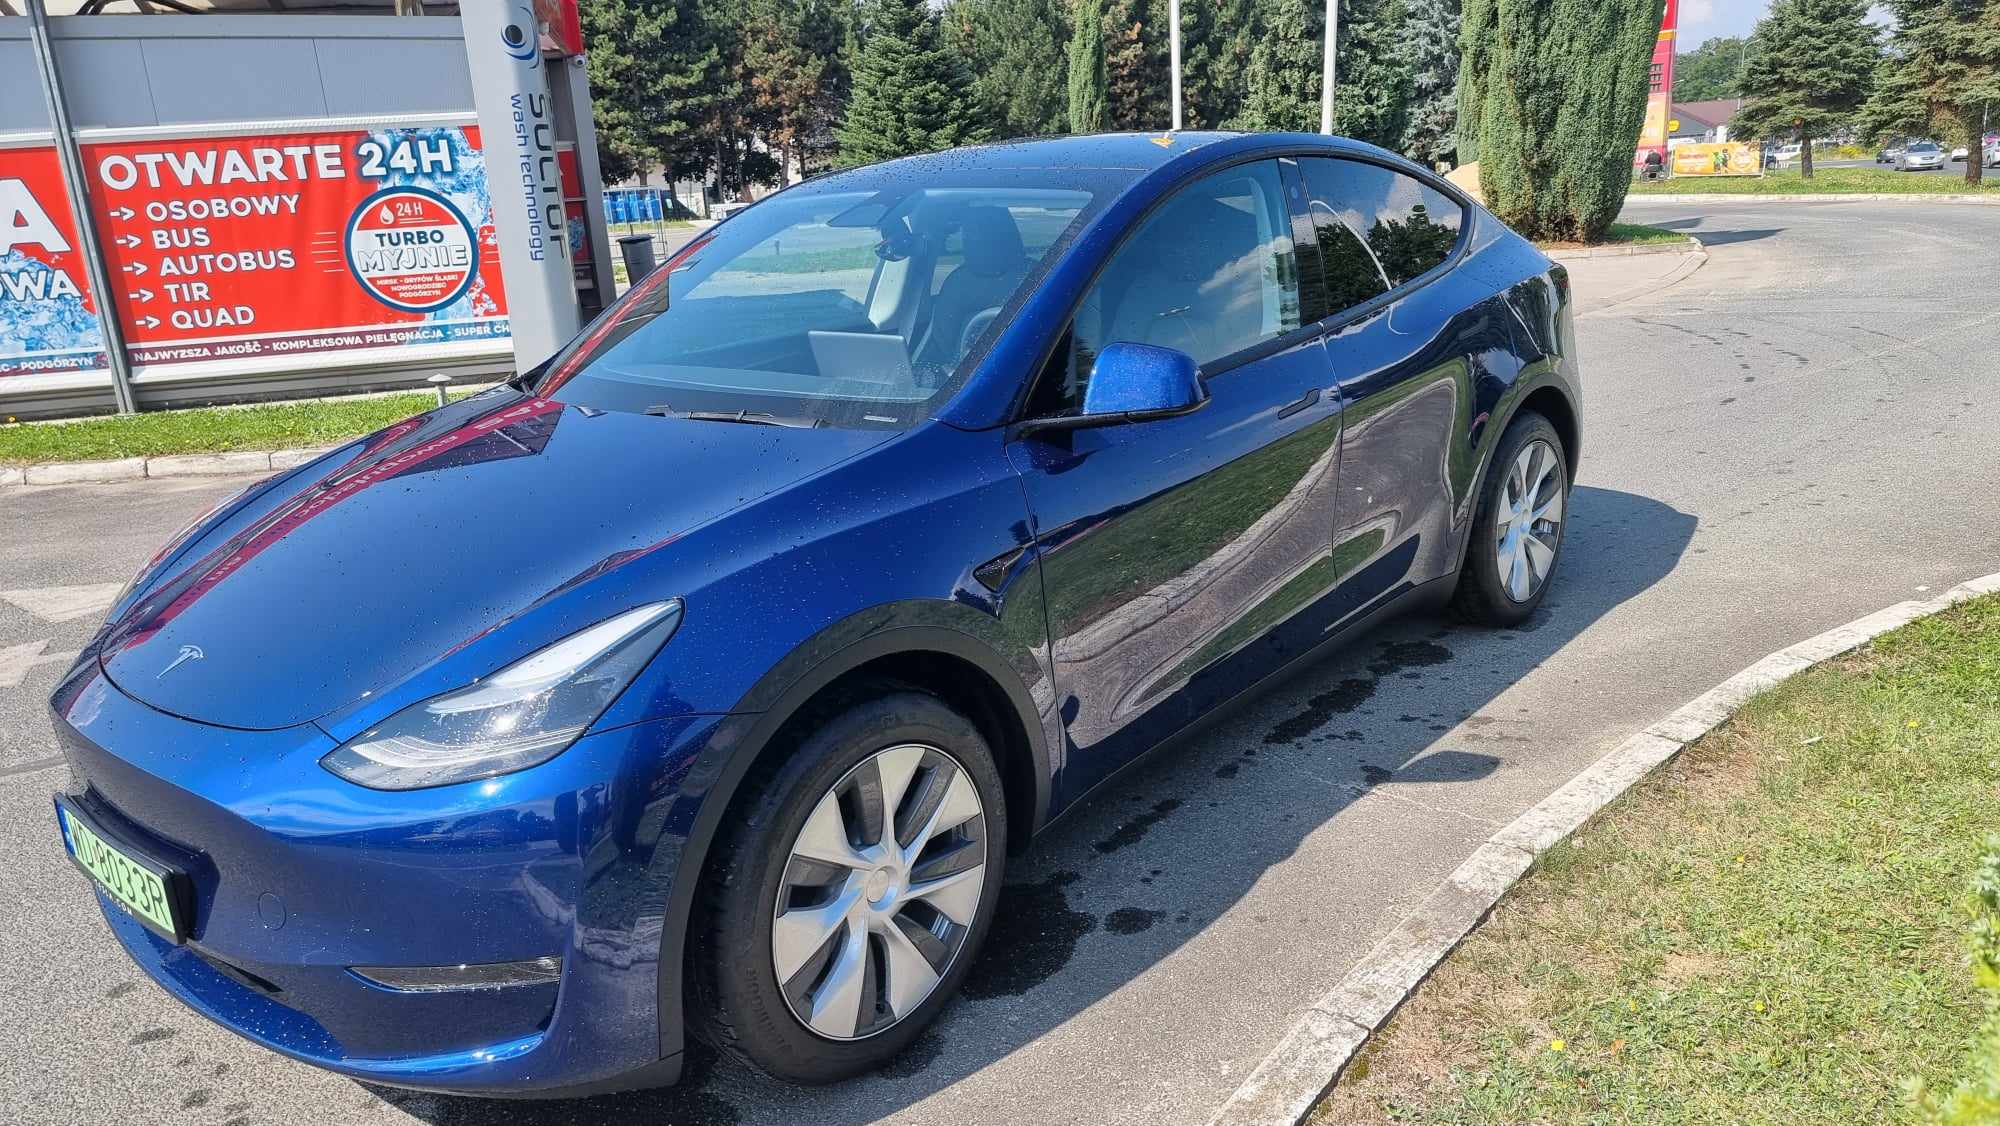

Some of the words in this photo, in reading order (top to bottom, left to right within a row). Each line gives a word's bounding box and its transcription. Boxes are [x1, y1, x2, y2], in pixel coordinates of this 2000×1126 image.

[510, 94, 530, 147] wash
[100, 144, 346, 191] OTWARTE
[358, 139, 453, 177] 24H
[146, 194, 300, 222] OSOBOWY
[519, 154, 546, 261] technology
[152, 227, 211, 250] BUS
[375, 229, 445, 248] TURBO
[160, 249, 296, 277] AUTOBUS
[357, 245, 469, 273] MYJNIE
[0, 268, 82, 301] WA
[164, 282, 212, 303] TIR
[171, 305, 255, 329] QUAD
[272, 335, 363, 351] KOMPLEKSOWA
[365, 329, 445, 344] PIELĘGNACJA
[454, 325, 492, 337] SUPER
[494, 324, 511, 334] CH
[20, 356, 94, 371] PODGÓRZYN
[95, 838, 169, 925] 8033R
